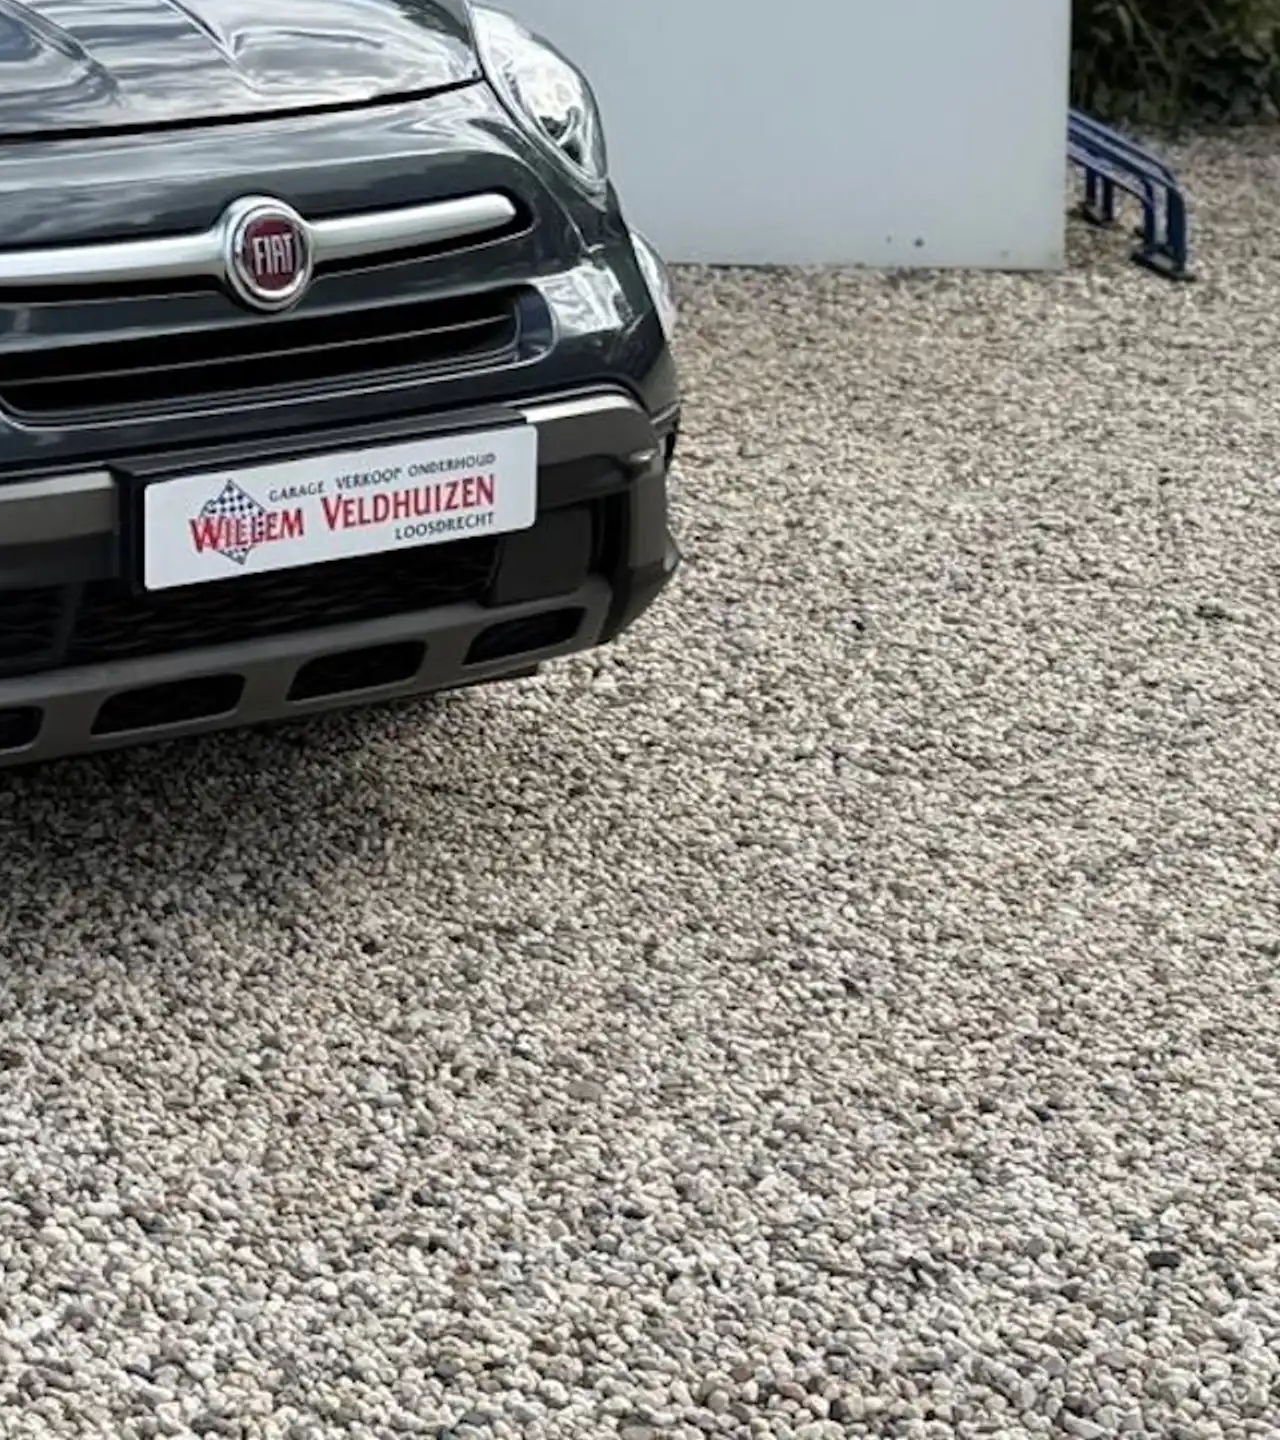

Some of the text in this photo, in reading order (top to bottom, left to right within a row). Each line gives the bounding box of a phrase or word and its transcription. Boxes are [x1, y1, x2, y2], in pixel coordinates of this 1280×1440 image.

[251, 232, 294, 276] FIAT
[268, 452, 497, 503] GARAGE VERKOOP ONDERHOUD
[190, 473, 495, 553] WILLEM VELDHUIZEN
[395, 512, 495, 540] LOOSDRECHT
